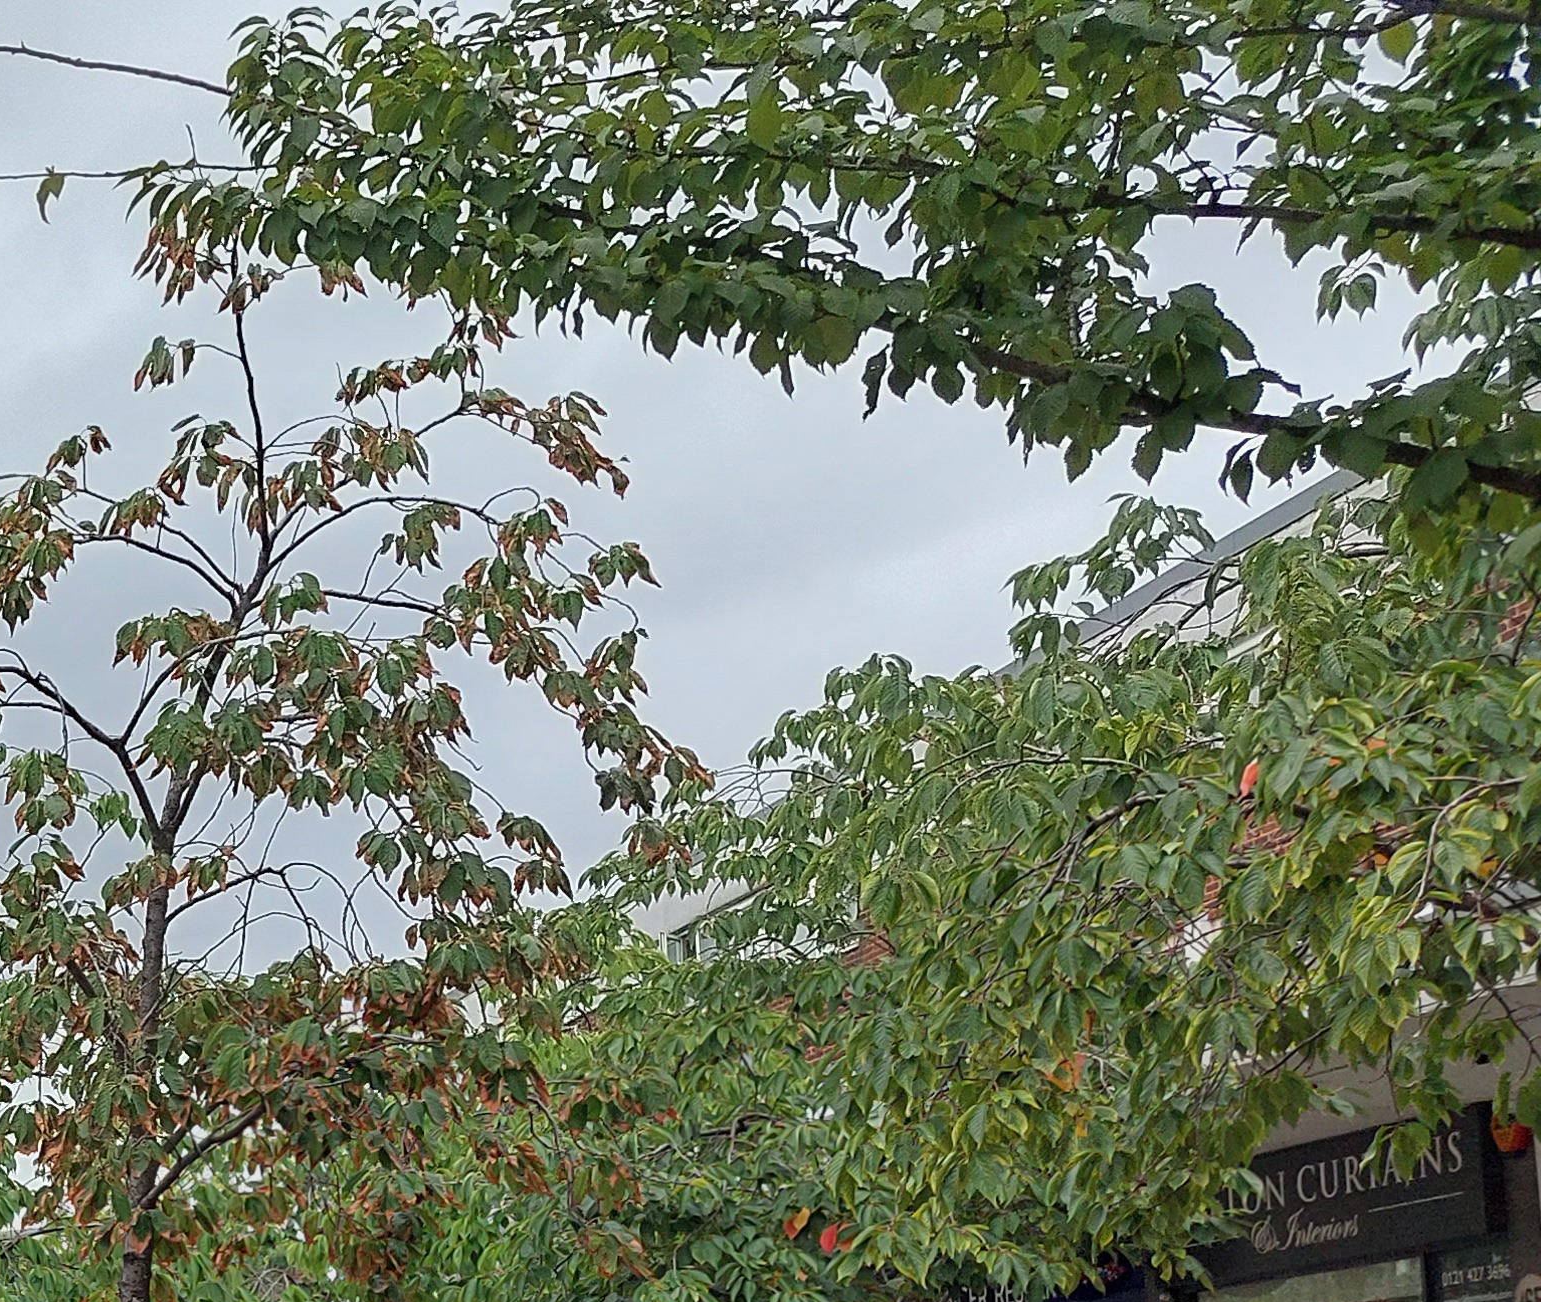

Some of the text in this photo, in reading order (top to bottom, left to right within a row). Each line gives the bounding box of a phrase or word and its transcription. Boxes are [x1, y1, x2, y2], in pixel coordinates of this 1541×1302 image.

[1280, 1207, 1359, 1250] Interiors
[1442, 1270, 1464, 1286] 0121
[1467, 1266, 1484, 1282] 427
